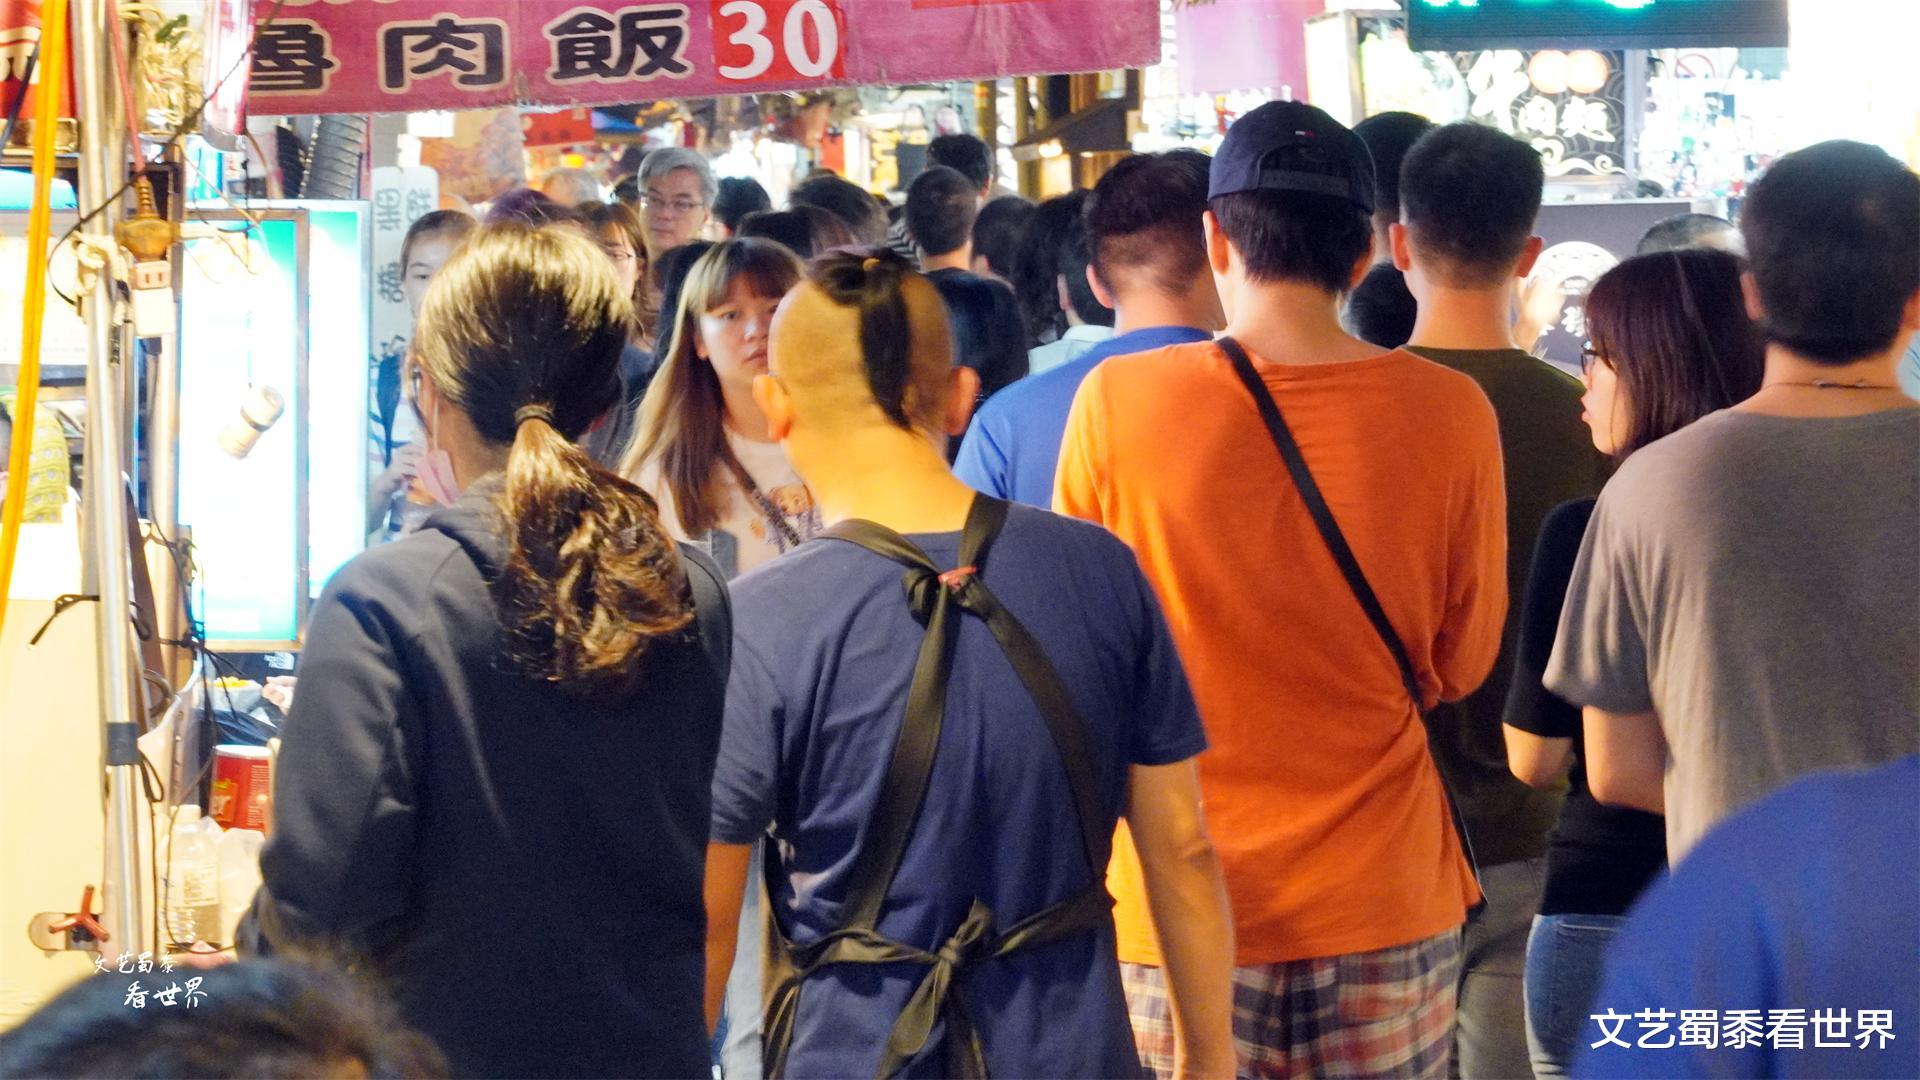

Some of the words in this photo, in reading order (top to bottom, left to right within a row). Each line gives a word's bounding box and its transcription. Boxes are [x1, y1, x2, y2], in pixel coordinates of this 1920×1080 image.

[248, 8, 690, 92] 魯肉飯
[718, 0, 839, 80] 30
